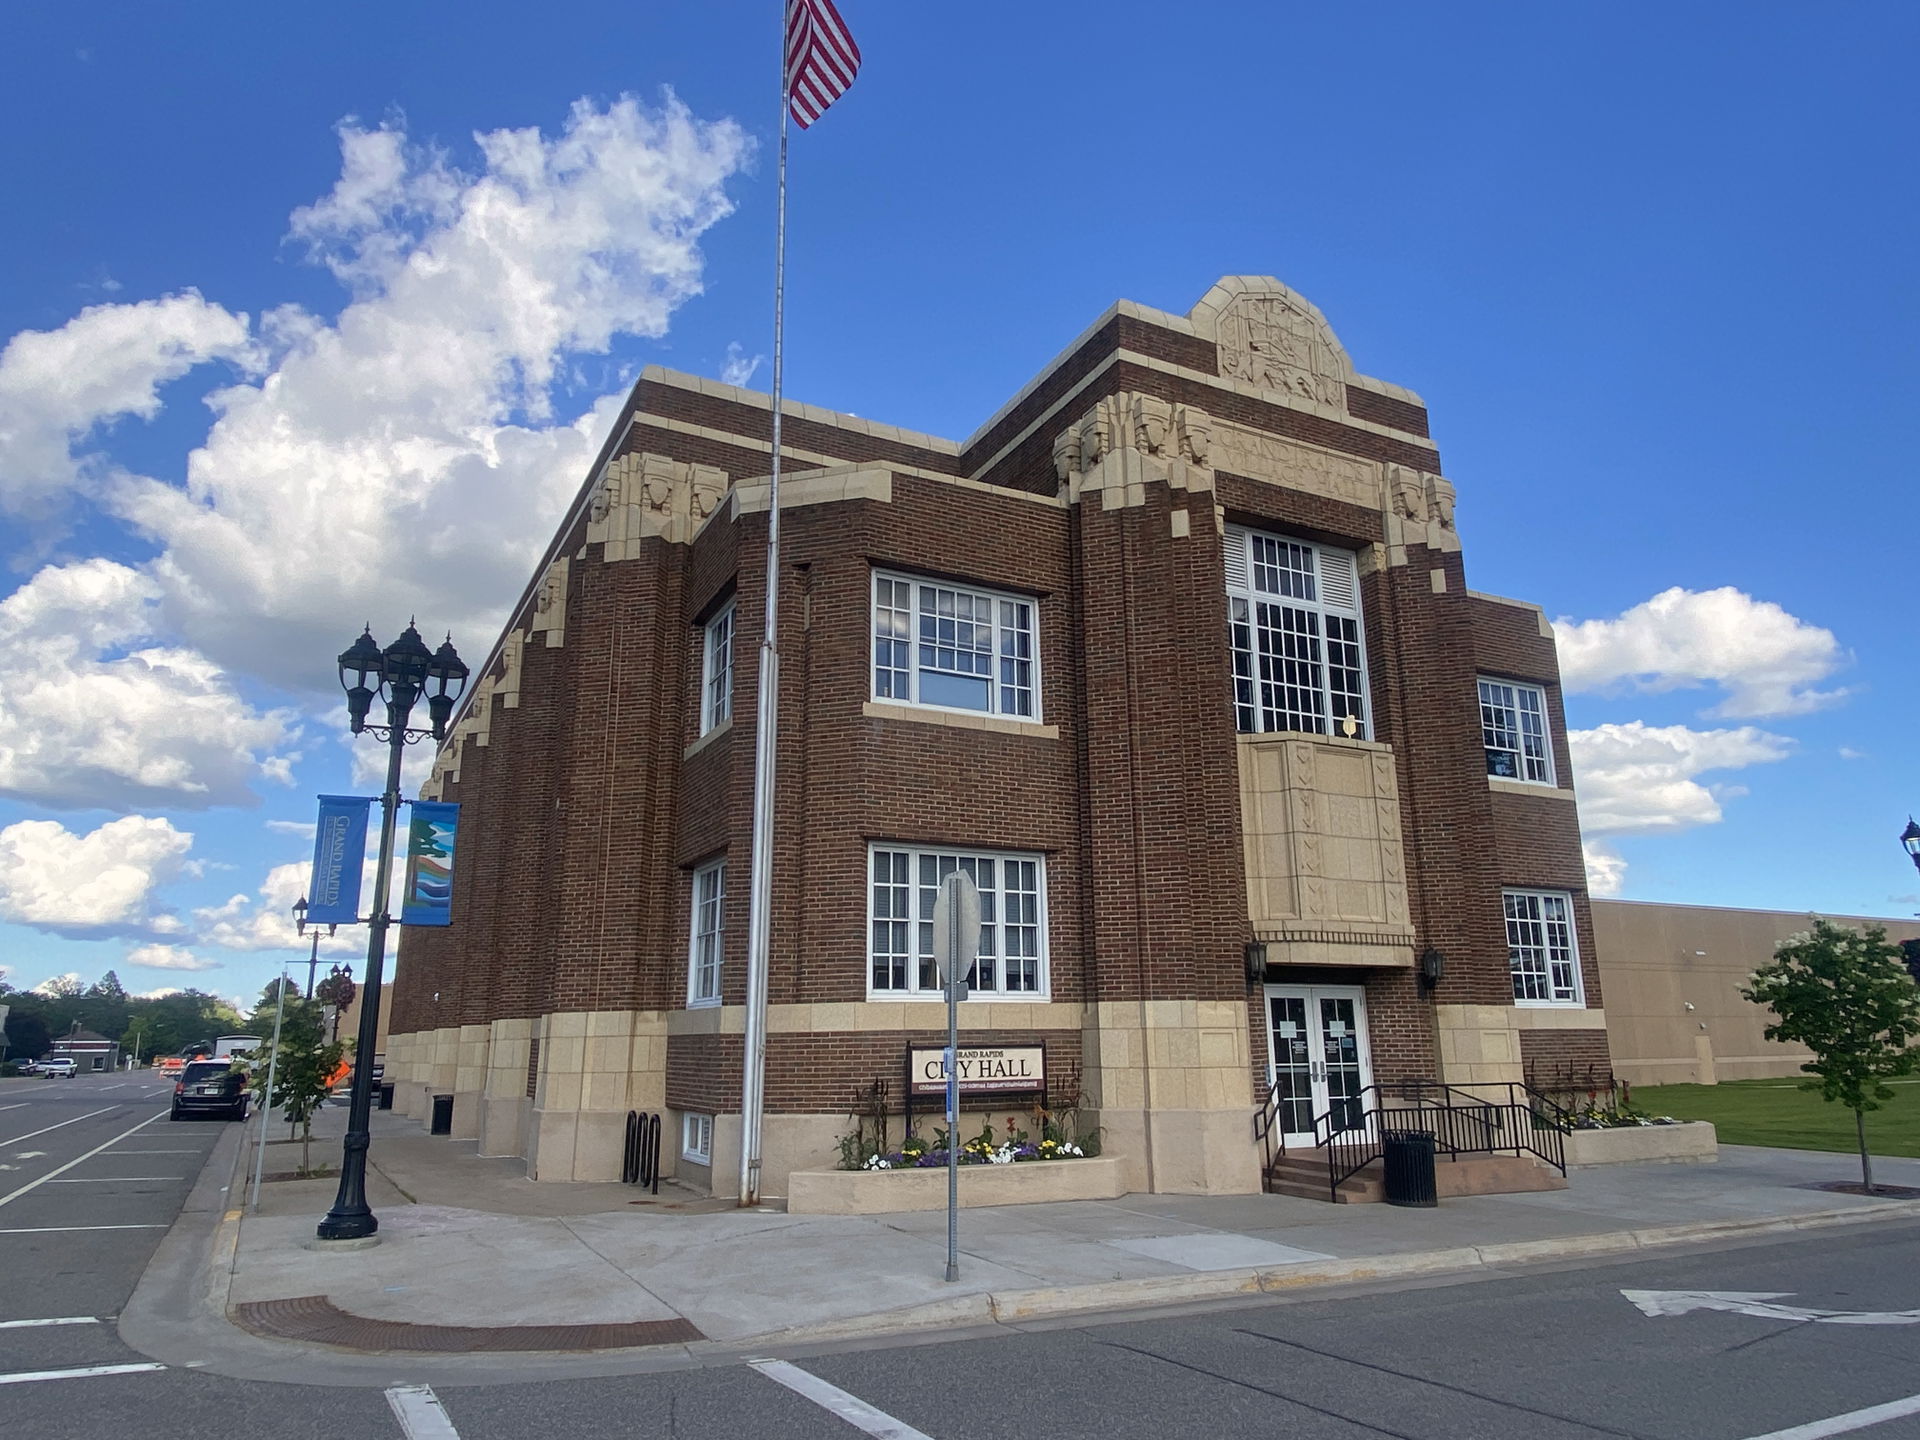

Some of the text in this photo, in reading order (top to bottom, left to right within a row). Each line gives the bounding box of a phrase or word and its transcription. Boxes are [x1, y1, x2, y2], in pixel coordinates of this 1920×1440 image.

[1220, 430, 1290, 462] GRAND
[328, 816, 350, 906] GRAND RAPIDS
[980, 1050, 1003, 1059] RAPIDS
[925, 1059, 1031, 1079] CIY HALL
